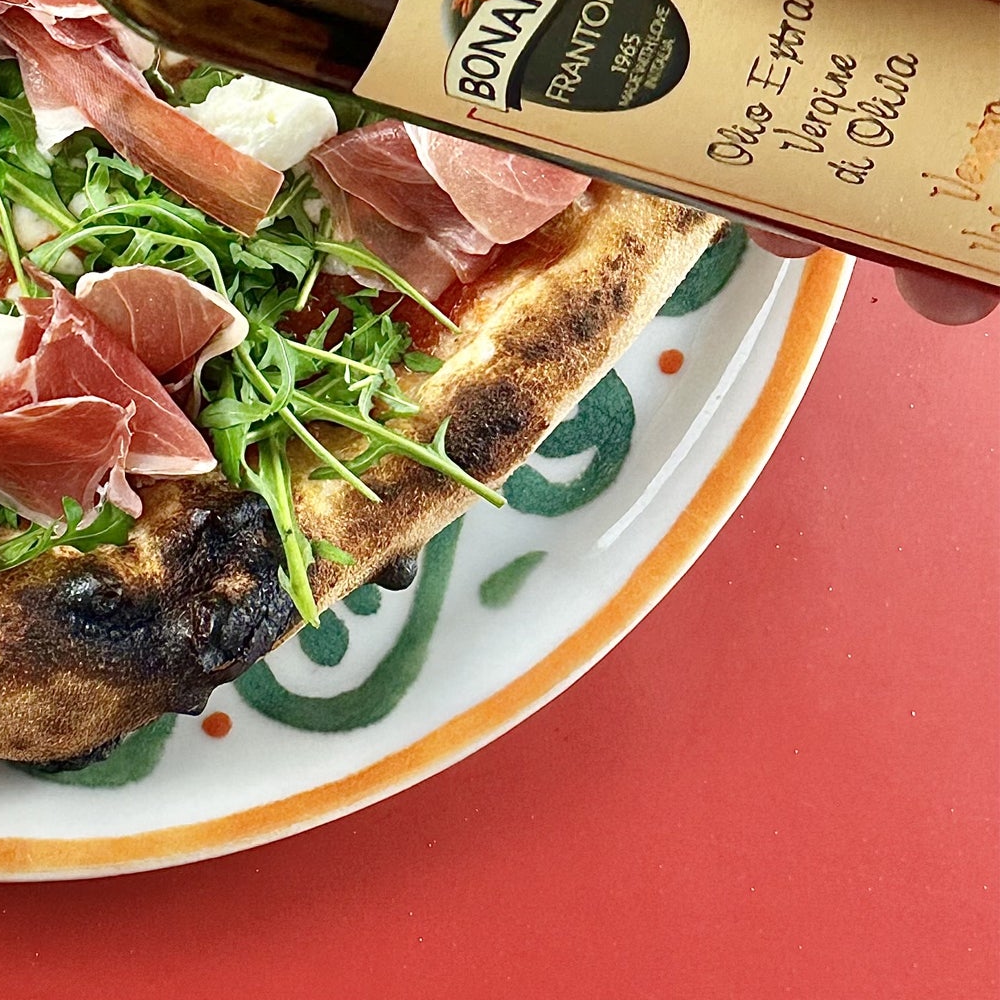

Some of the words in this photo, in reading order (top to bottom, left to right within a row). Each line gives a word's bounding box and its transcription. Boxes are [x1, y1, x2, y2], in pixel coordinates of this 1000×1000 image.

[610, 32, 641, 73] 1965
[773, 52, 858, 153] Vergine
[846, 52, 920, 148] Oliva
[706, 101, 774, 166] Olio
[827, 156, 875, 185] di
